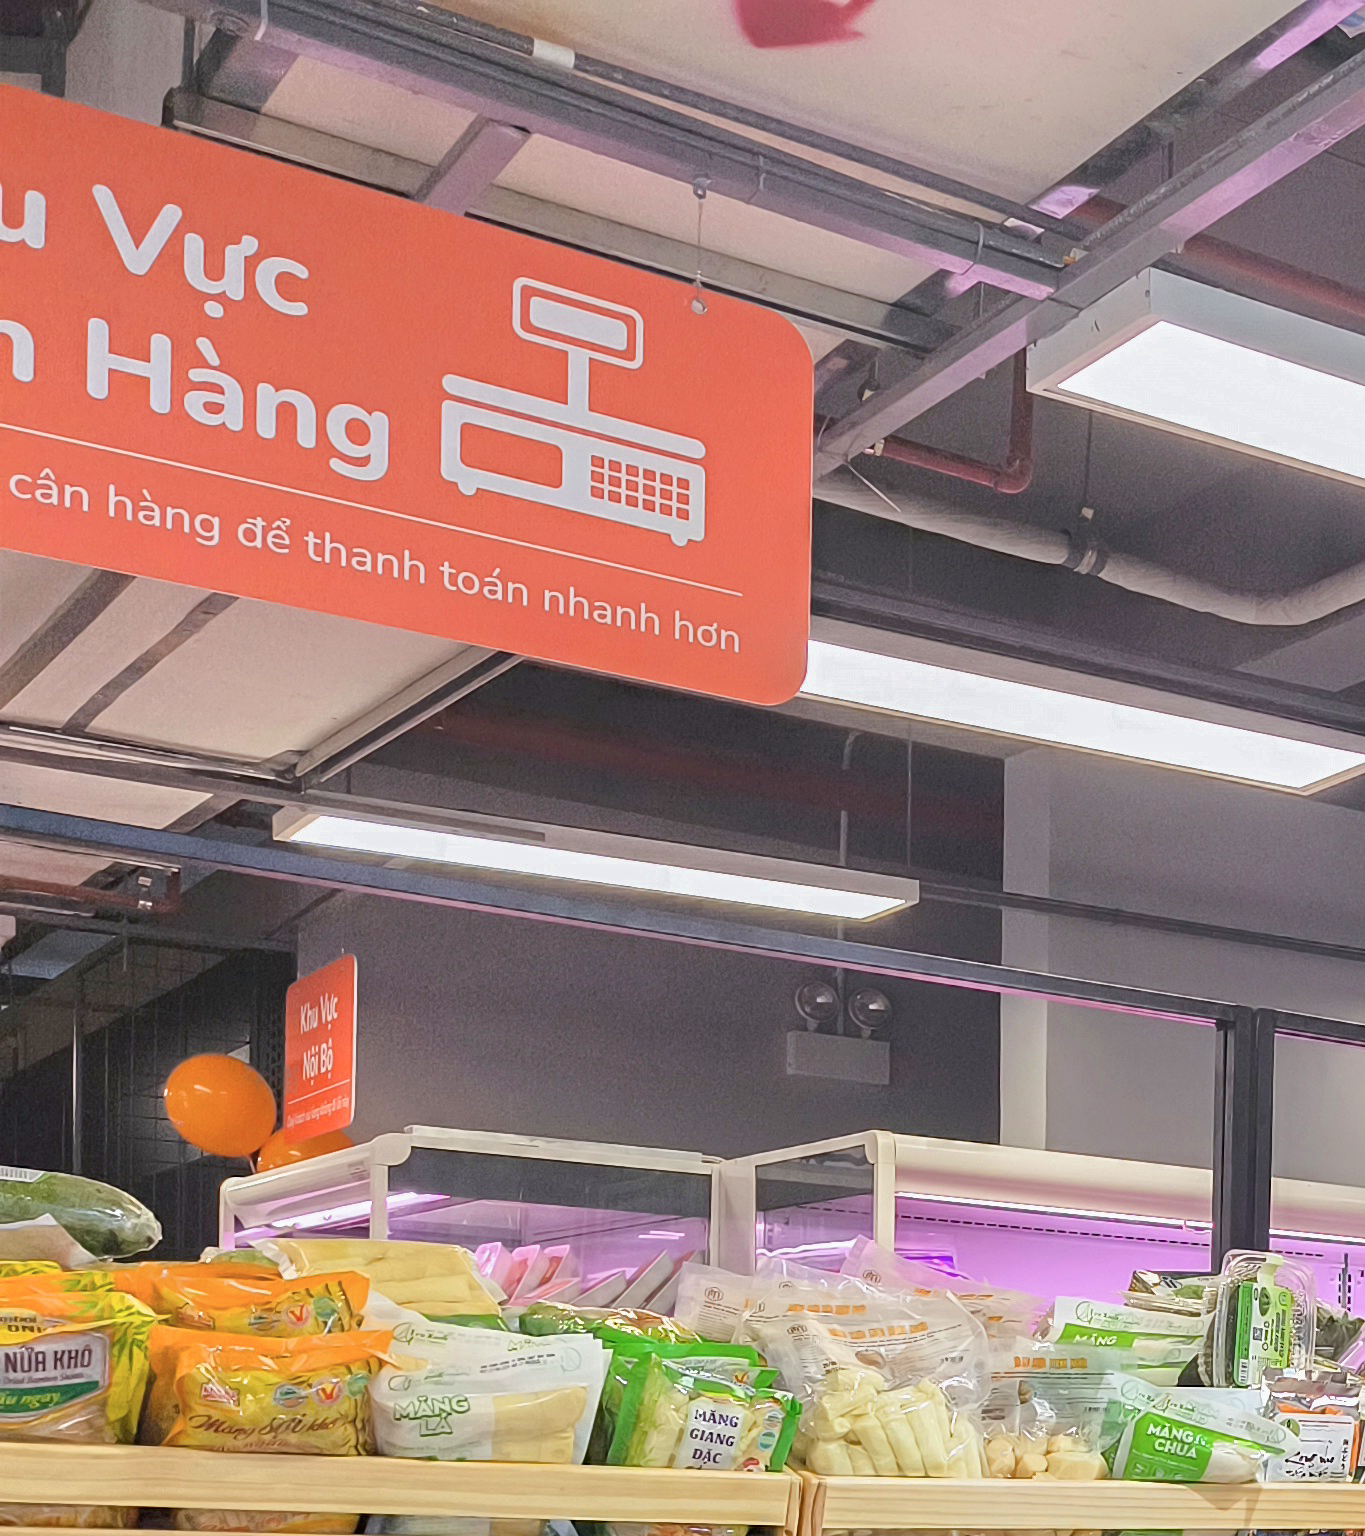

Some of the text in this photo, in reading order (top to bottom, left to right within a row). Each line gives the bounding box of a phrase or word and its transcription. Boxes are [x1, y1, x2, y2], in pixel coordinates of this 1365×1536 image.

[92, 183, 310, 318] Vực
[87, 317, 390, 482] Hàng
[9, 468, 740, 653] cân hàng để thanh toán nhanh hơn
[300, 992, 338, 1034] Khu Vực
[303, 1038, 334, 1086] Nội Bộ
[53, 1344, 93, 1370] KHÔ
[393, 1393, 471, 1422] MĂNG
[693, 1406, 740, 1430] MĂNG
[688, 1427, 737, 1448] GIANG
[1147, 1421, 1194, 1444] MĂNG
[1155, 1440, 1198, 1459] CHUA
